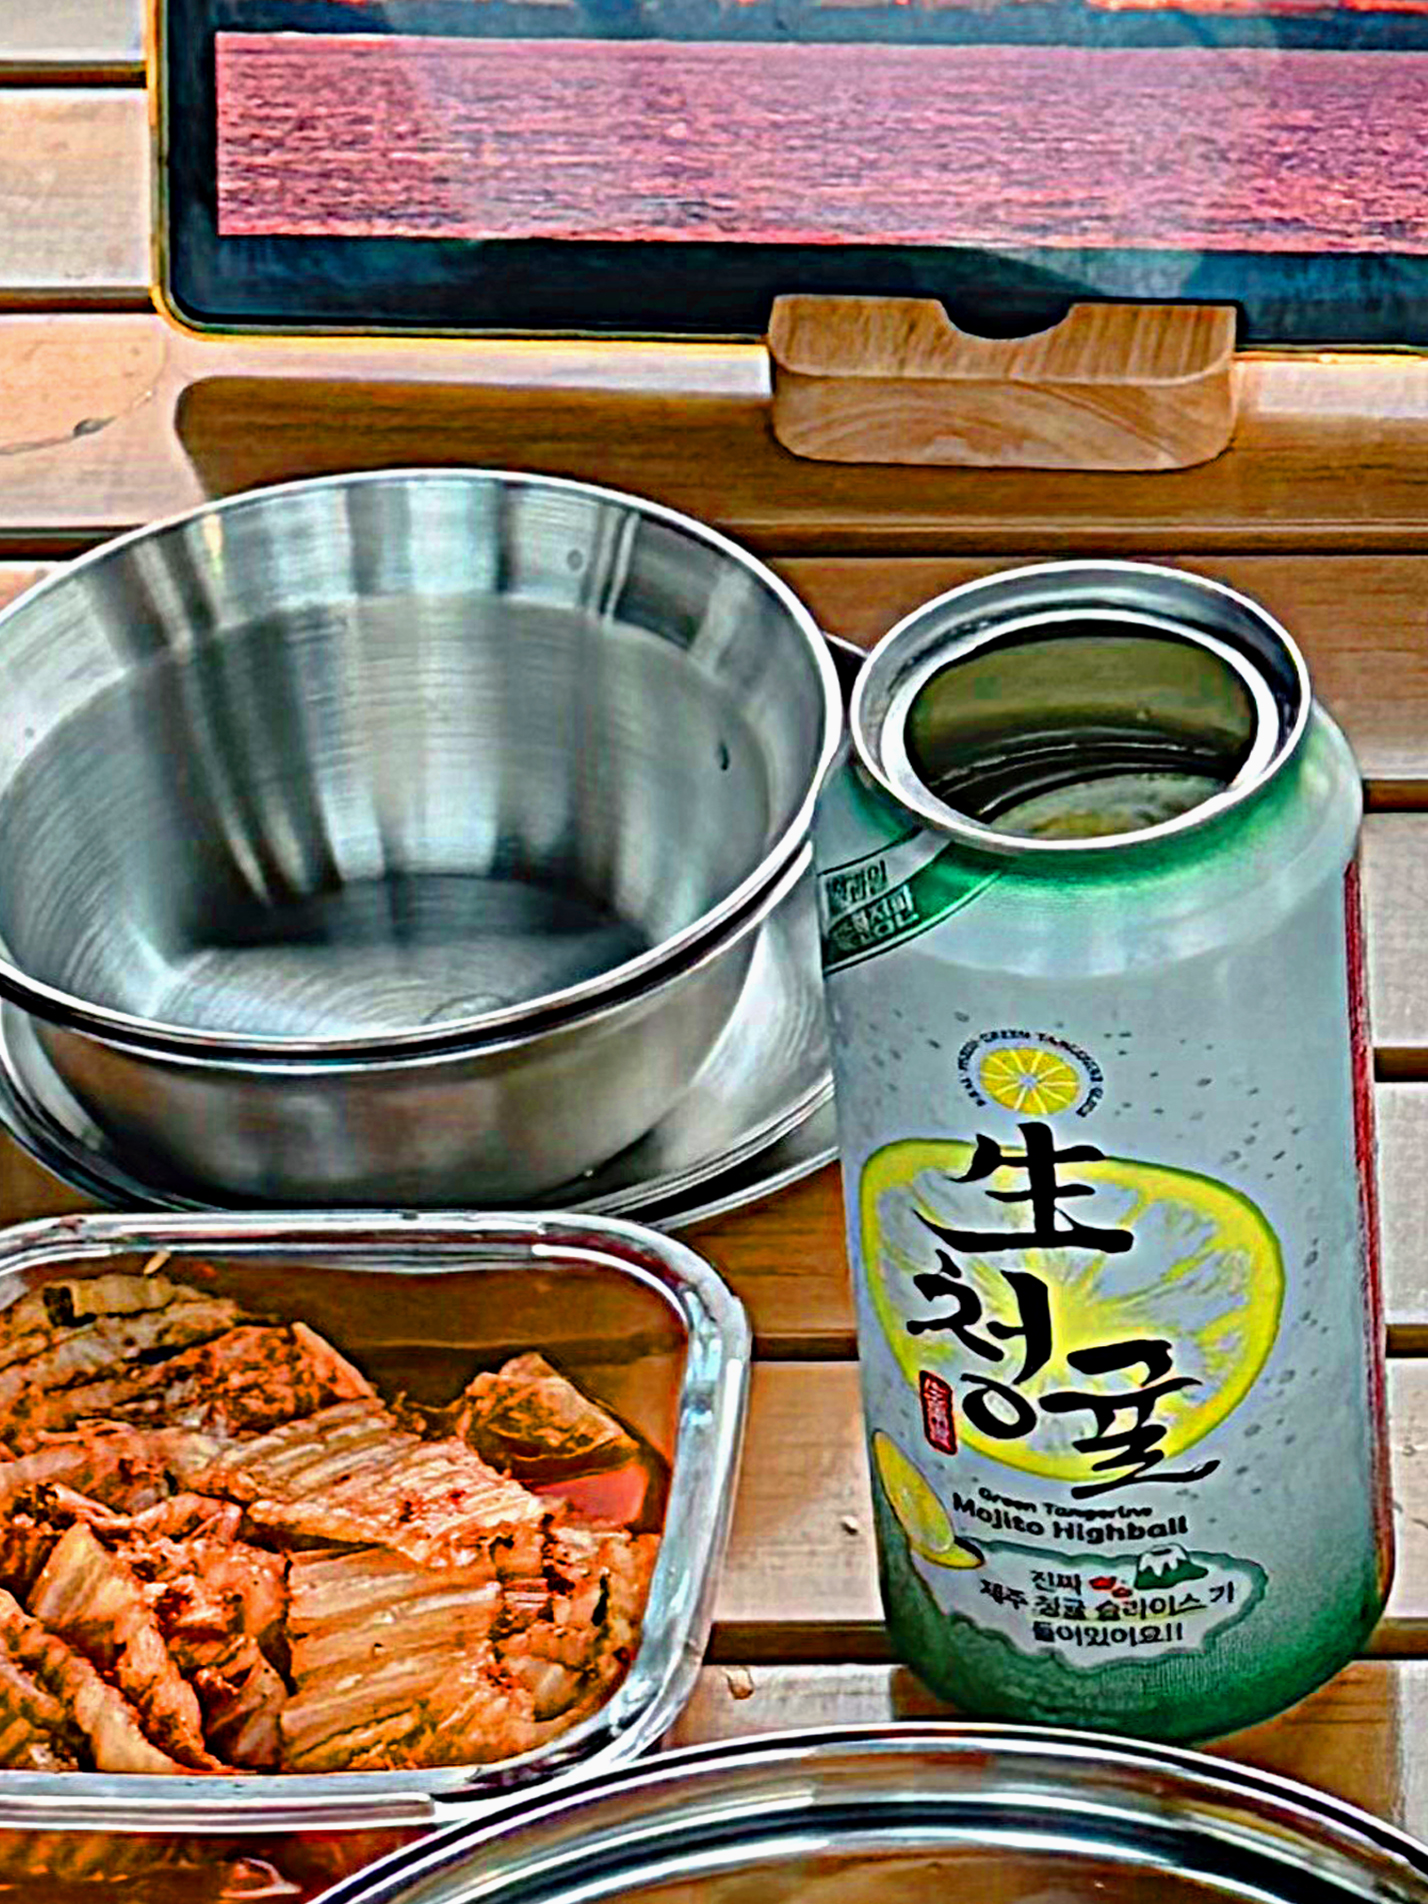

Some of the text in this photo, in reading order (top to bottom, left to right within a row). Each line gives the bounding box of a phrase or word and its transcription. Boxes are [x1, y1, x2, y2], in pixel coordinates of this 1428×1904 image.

[952, 1492, 1188, 1545] Mojito Highball
[978, 1487, 1153, 1521] Green Tangerine
